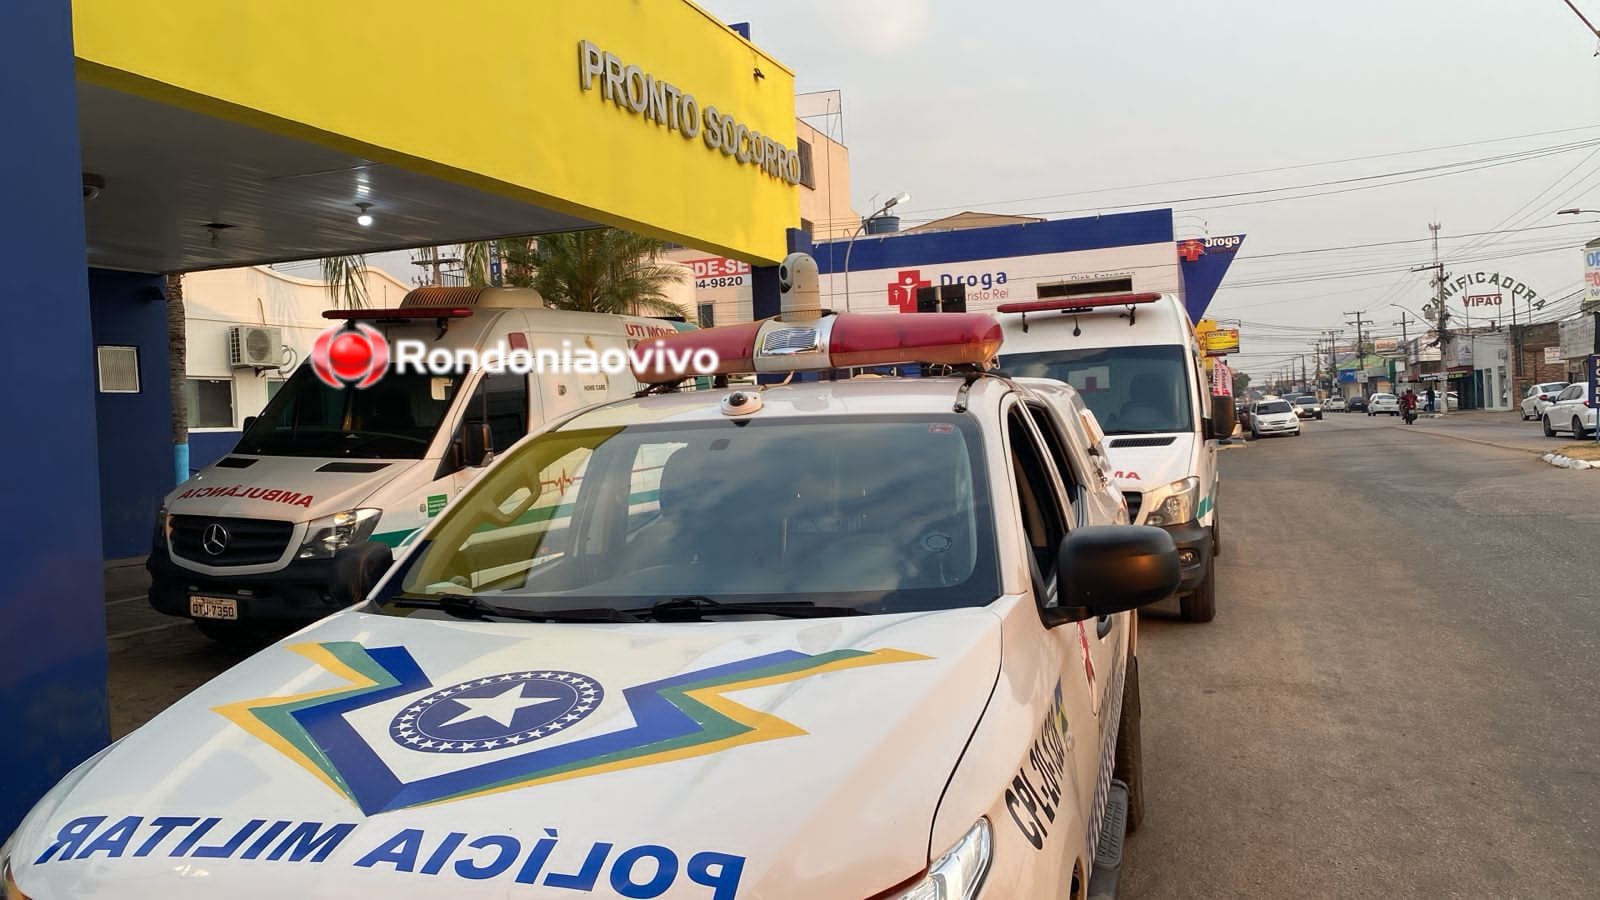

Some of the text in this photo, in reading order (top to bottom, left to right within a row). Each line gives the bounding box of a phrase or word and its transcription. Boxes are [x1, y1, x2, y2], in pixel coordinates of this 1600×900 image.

[578, 40, 801, 185] PRONTO SOCORRO
[696, 276, 743, 289] 4-9820
[941, 271, 1007, 290] Droga
[967, 291, 990, 301] risto
[625, 324, 645, 337] UTI
